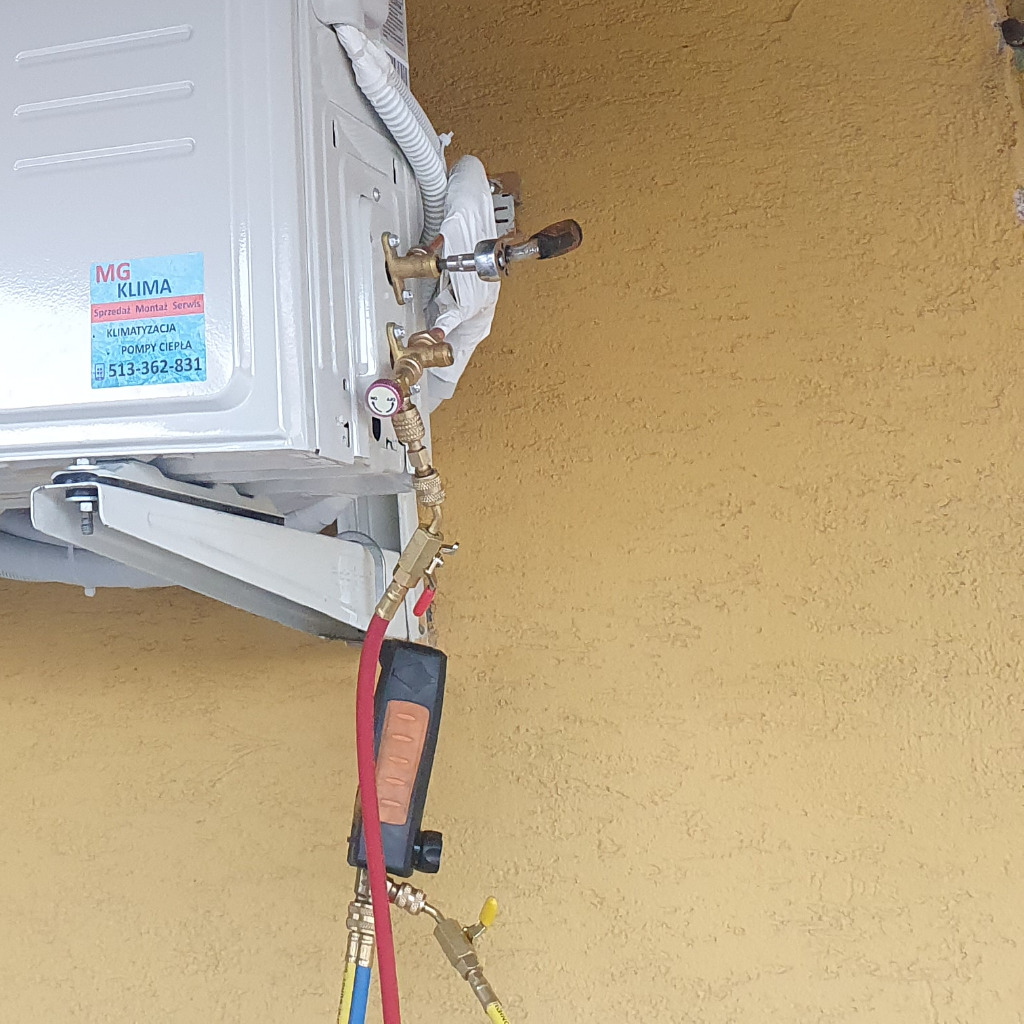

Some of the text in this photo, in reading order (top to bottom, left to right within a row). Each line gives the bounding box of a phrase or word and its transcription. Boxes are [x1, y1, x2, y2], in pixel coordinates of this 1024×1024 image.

[95, 262, 131, 283] MG
[117, 278, 172, 298] KLIMA
[94, 299, 201, 319] Sprzedaż Montaż Serwis
[106, 323, 177, 338] KLIMATYZACJA
[121, 340, 193, 355] POMPY CIEPŁA
[108, 357, 202, 377] 513-362-831
